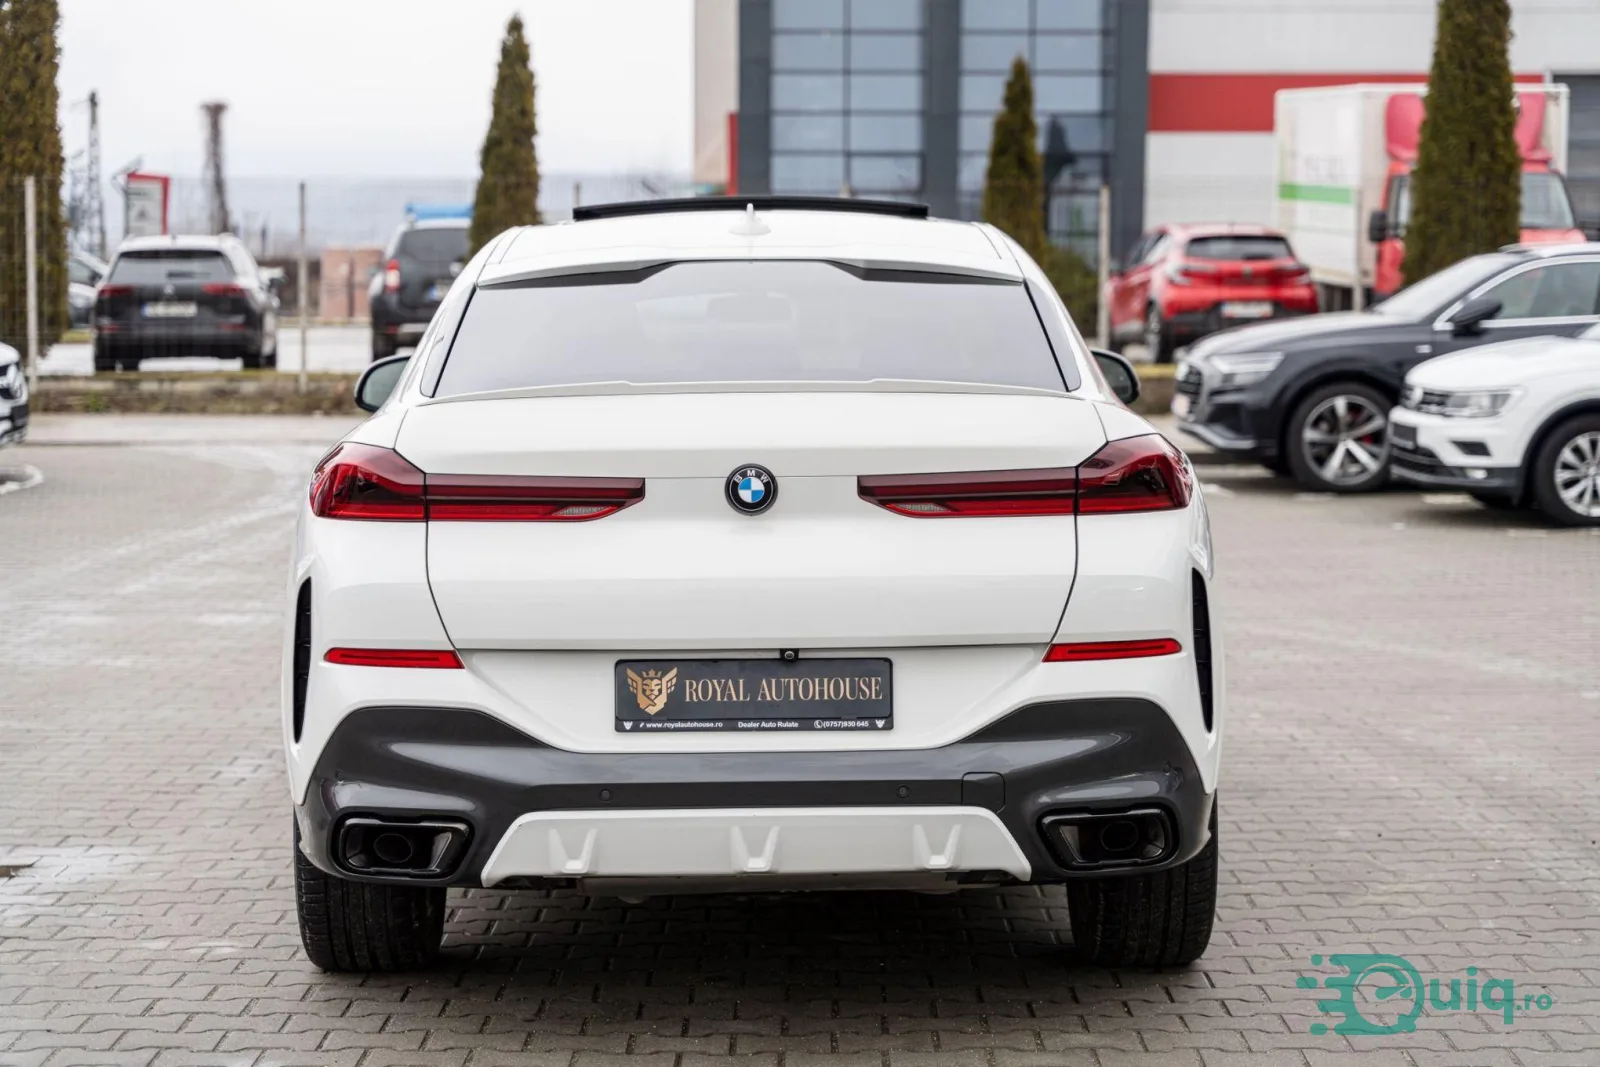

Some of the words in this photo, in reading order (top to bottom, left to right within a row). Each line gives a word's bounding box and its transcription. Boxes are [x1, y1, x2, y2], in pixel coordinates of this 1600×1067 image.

[733, 470, 768, 483] BMW
[685, 679, 750, 702] ROYAL
[757, 678, 882, 701] AUTOHOUSE
[646, 721, 723, 729] www.royalautohouse.ro
